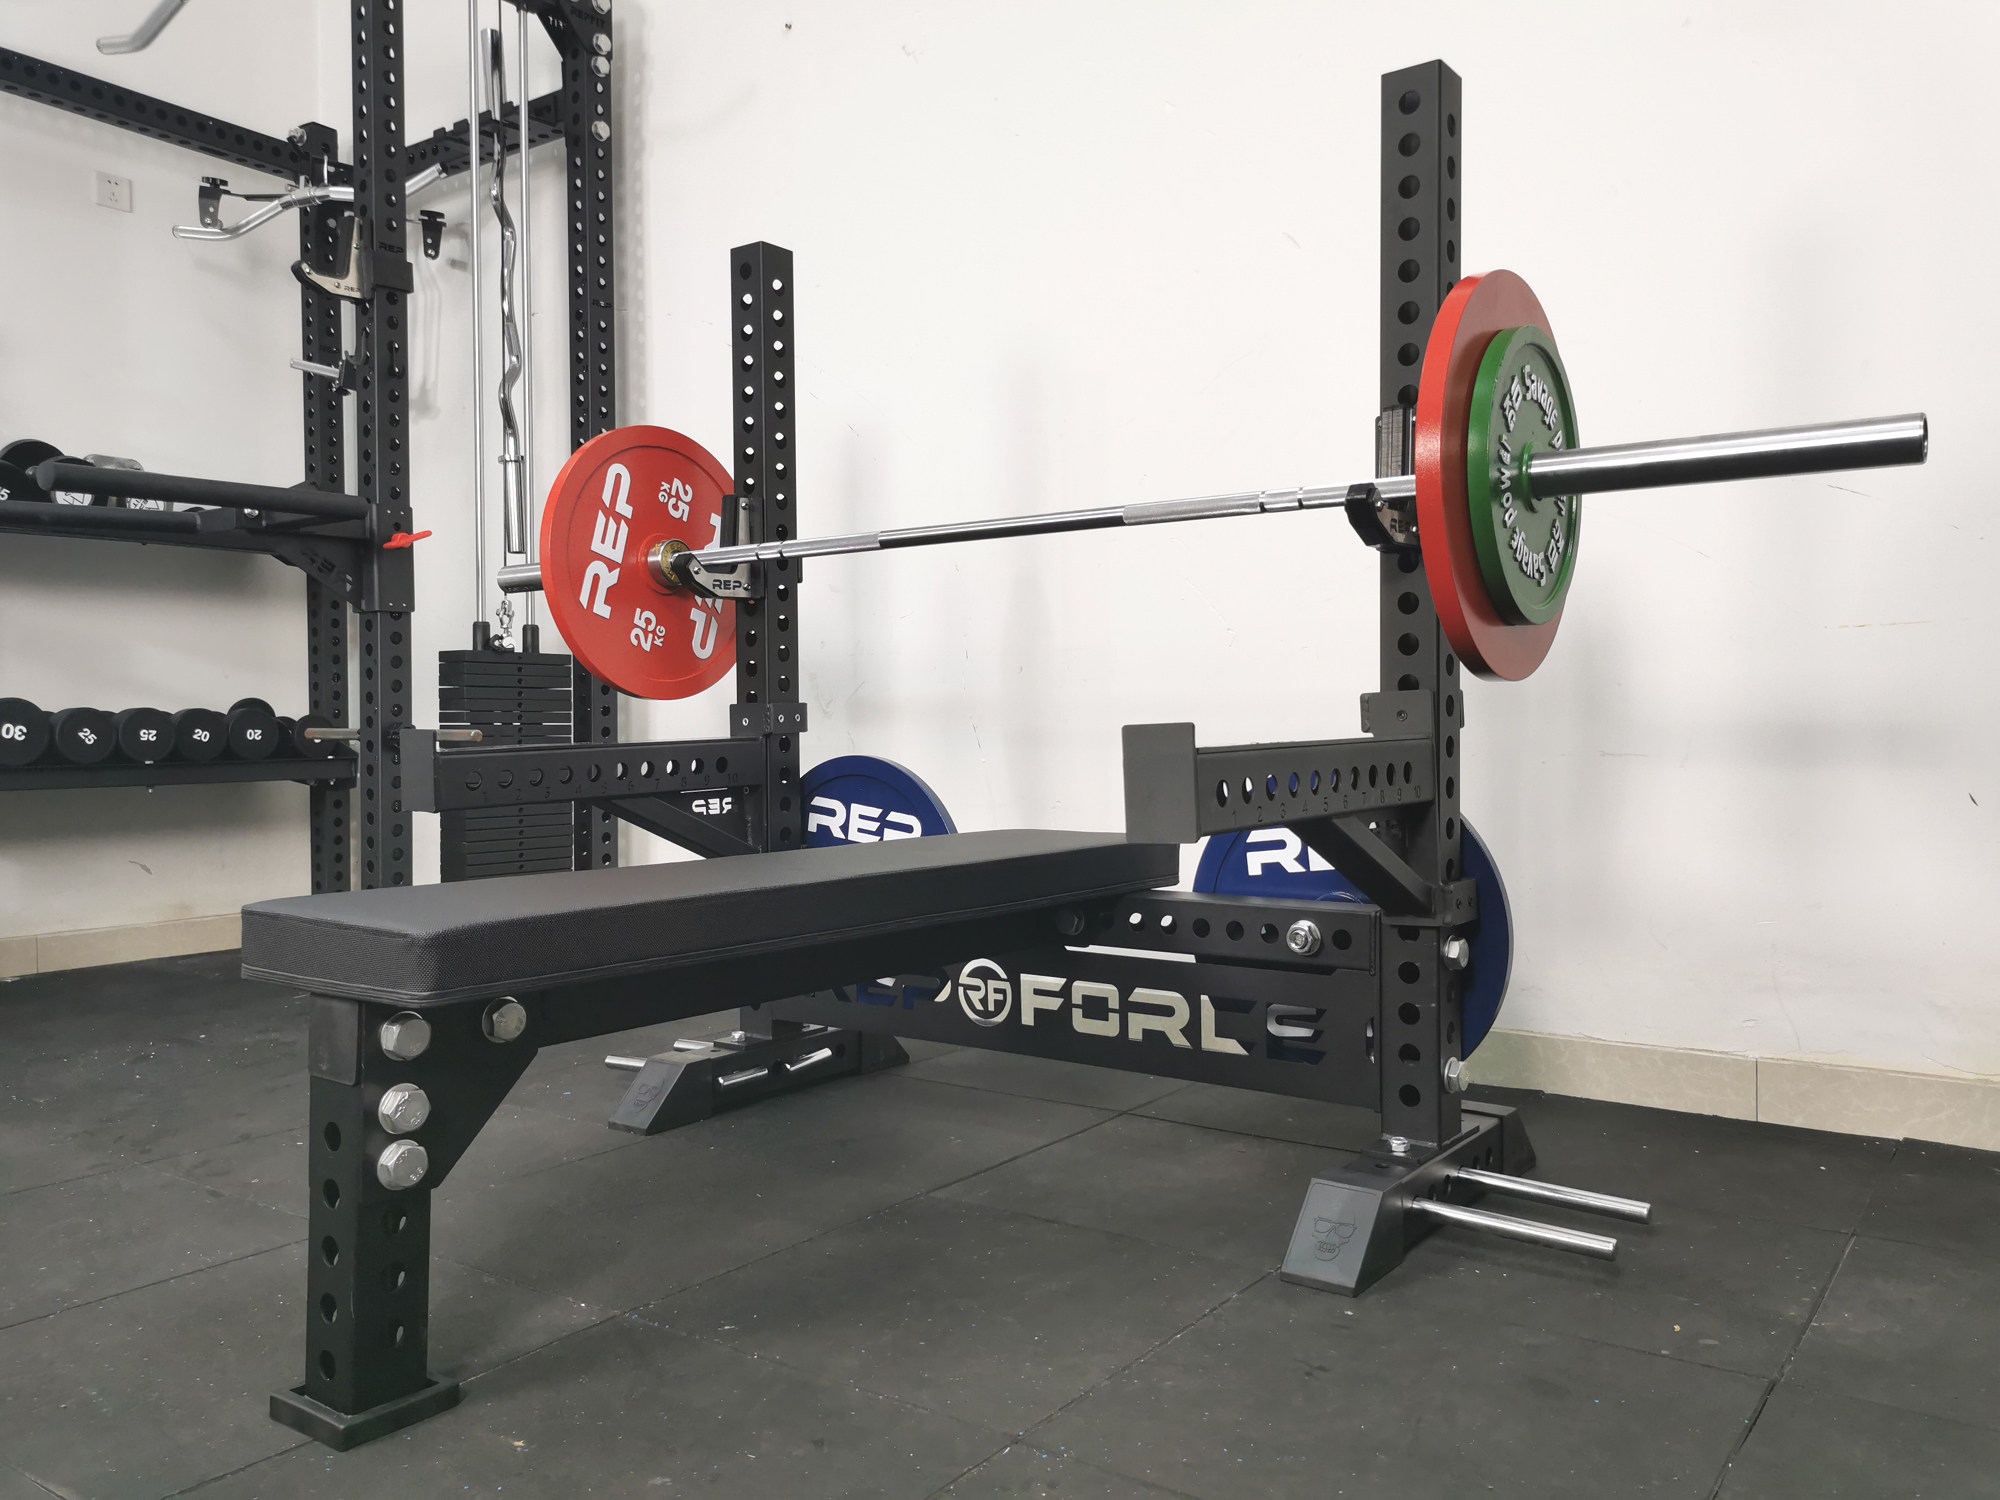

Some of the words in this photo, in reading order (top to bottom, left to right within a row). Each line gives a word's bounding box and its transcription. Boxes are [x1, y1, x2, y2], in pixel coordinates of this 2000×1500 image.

[379, 242, 404, 254] REP
[1510, 375, 1523, 411] 10
[1524, 364, 1558, 431] Savage
[0, 486, 11, 501] 5
[658, 481, 671, 503] KG
[668, 478, 693, 522] 25
[579, 463, 634, 620] REP
[712, 579, 742, 590] REP
[630, 608, 657, 652] 25
[653, 625, 666, 647] KG
[1, 723, 27, 741] 30
[78, 728, 98, 745] 25
[140, 729, 157, 742] 25
[193, 728, 210, 742] 20
[246, 729, 262, 741] 20
[807, 795, 922, 843] REP
[1020, 973, 1328, 1066] FORCE
